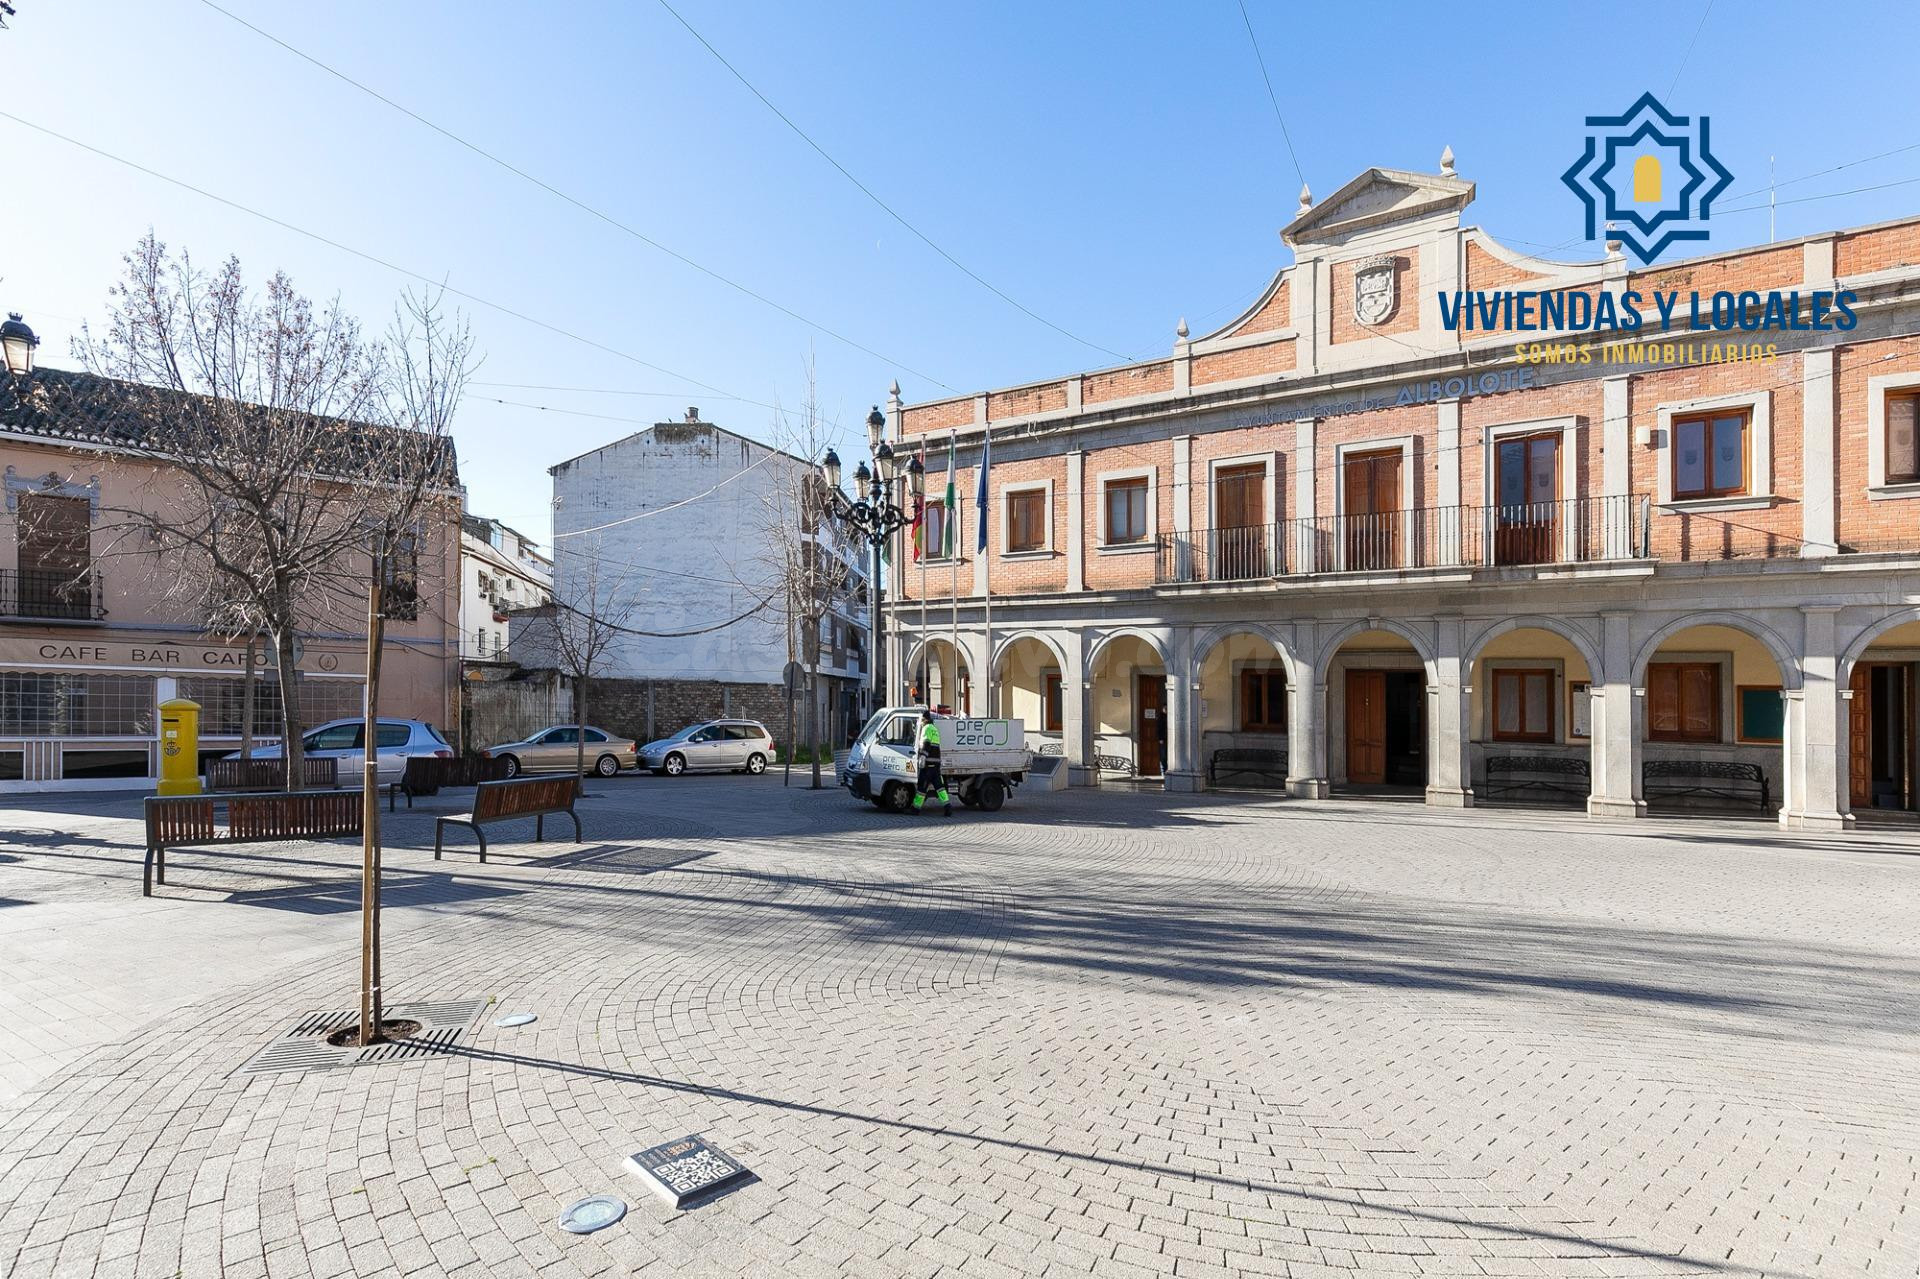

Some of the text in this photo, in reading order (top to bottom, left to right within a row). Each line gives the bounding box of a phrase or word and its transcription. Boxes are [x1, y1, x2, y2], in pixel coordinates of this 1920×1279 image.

[1394, 366, 1535, 406] ALBOLOTE
[39, 645, 107, 661] CAFE
[131, 649, 181, 663] BAR
[956, 720, 984, 734] pre
[956, 734, 994, 746] zero
